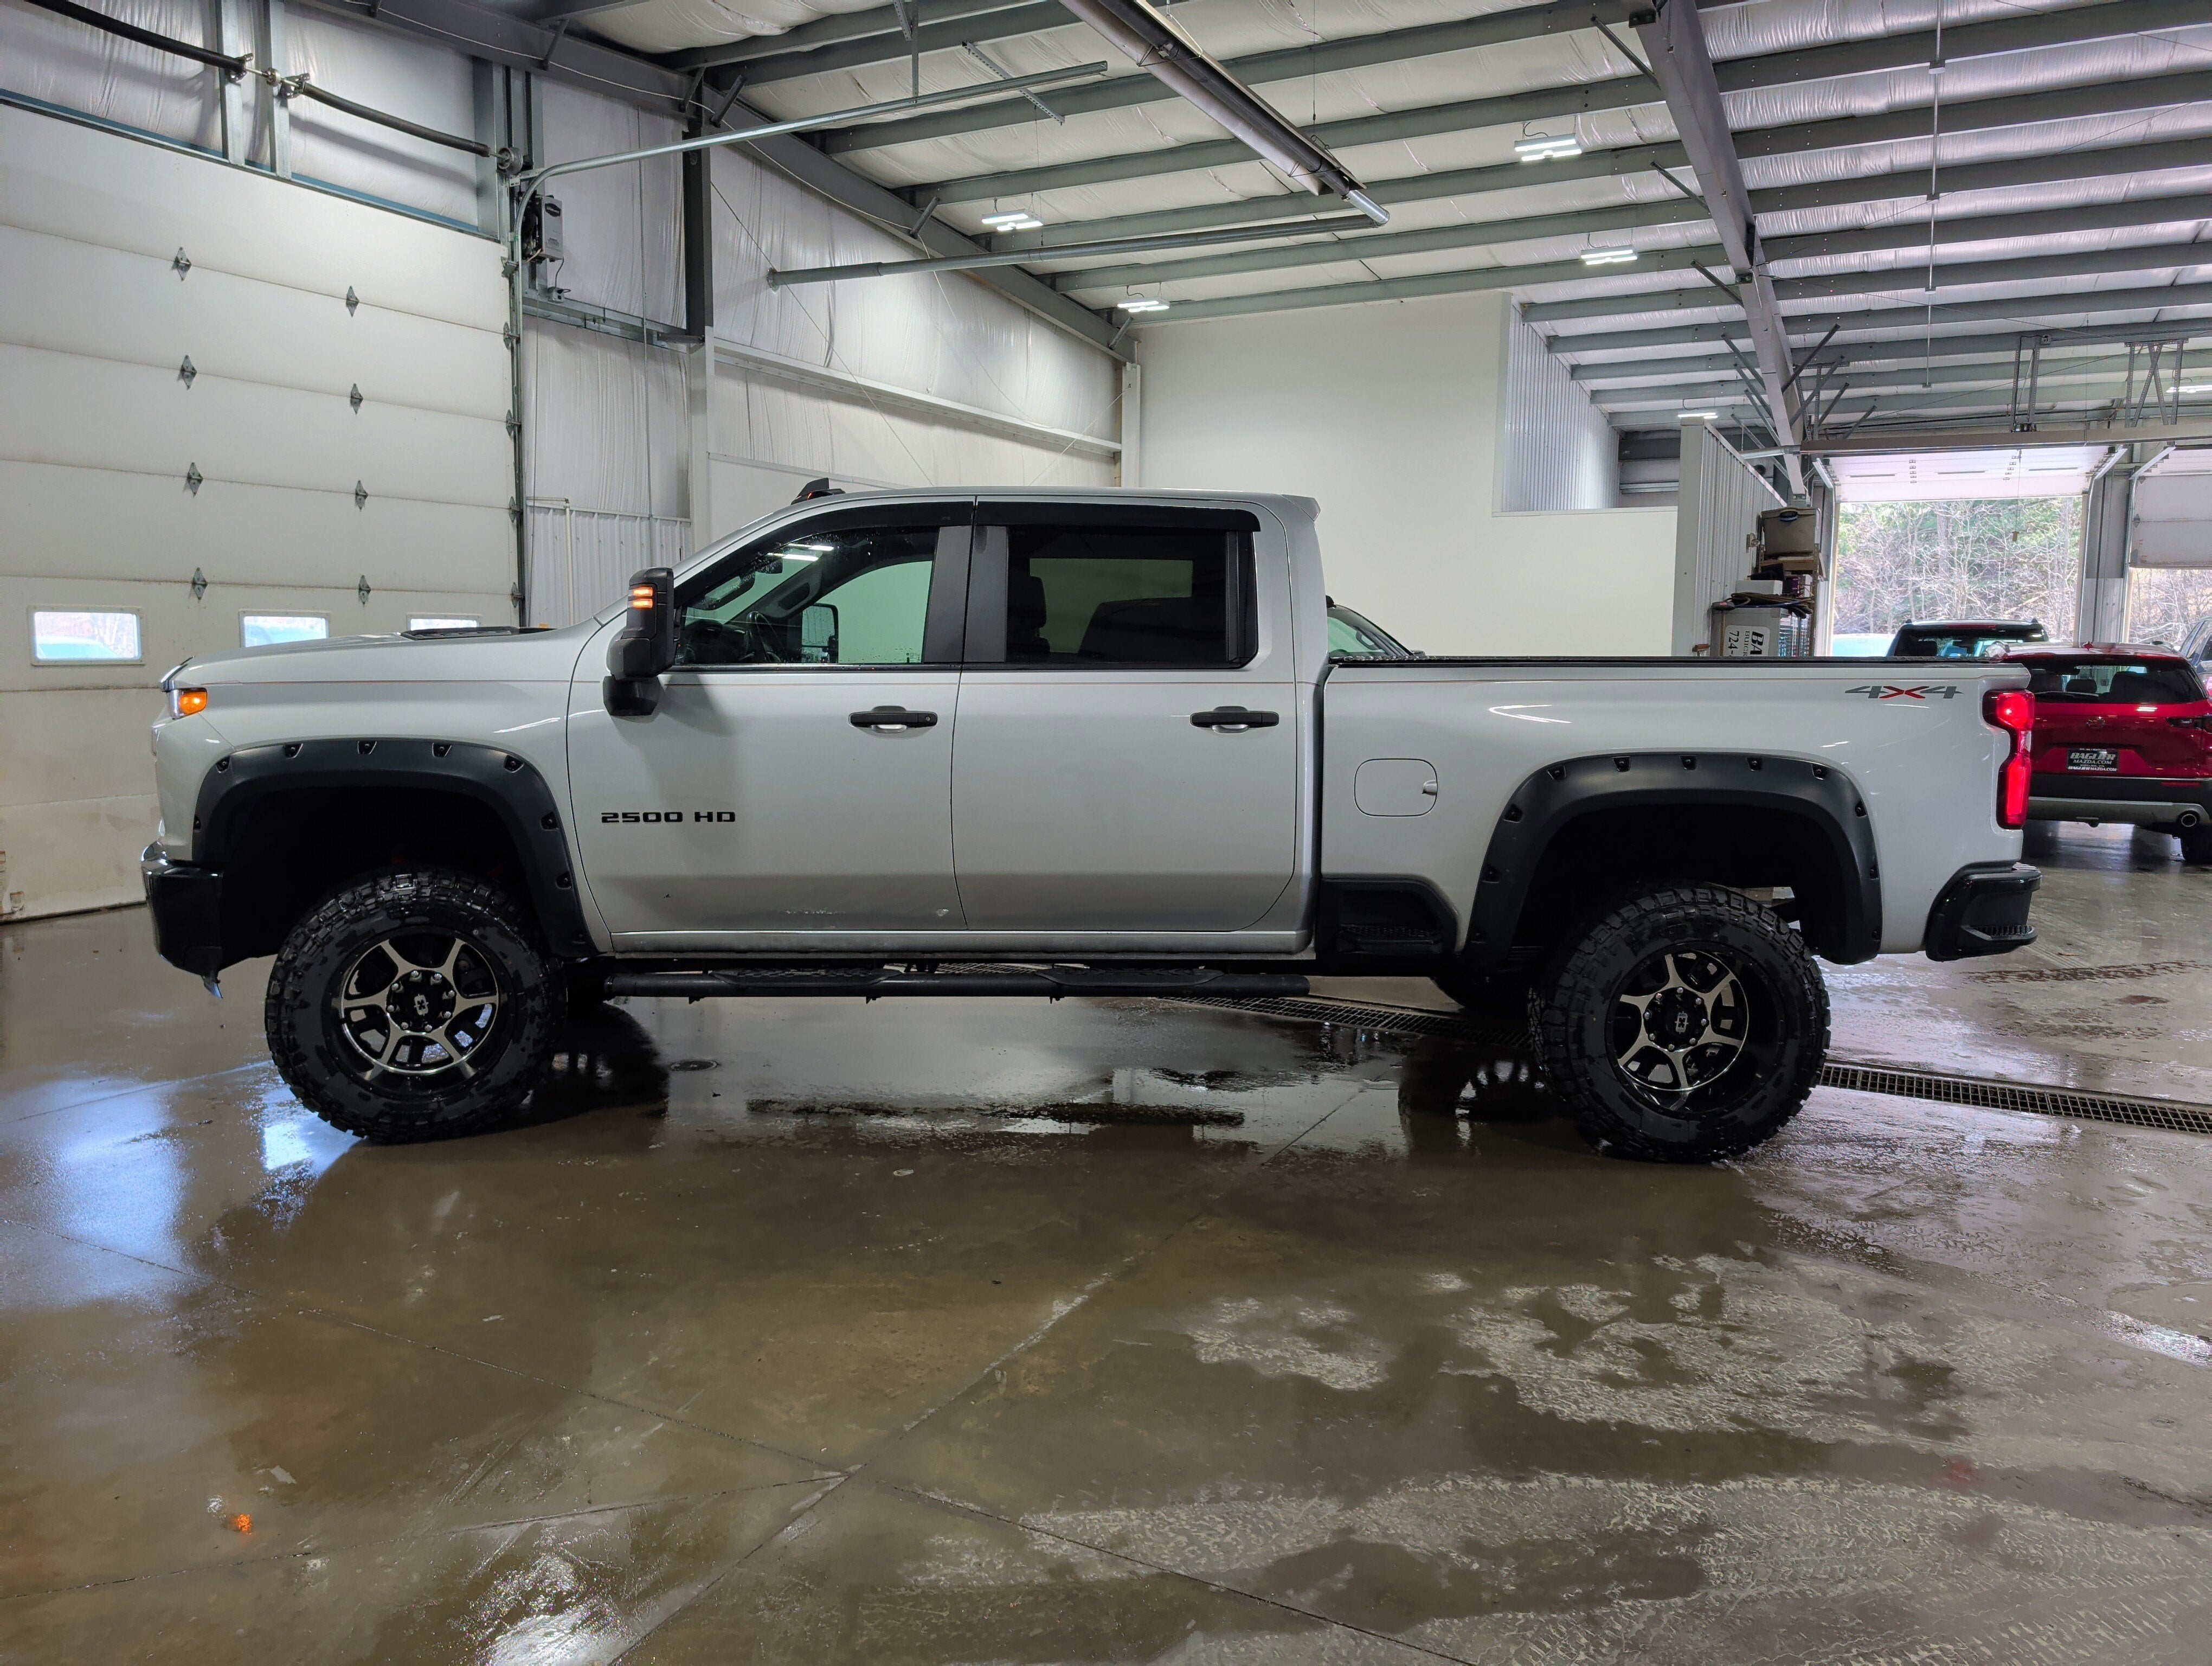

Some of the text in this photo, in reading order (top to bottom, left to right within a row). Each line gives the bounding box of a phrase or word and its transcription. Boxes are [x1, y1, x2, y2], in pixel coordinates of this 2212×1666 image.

[1728, 631, 1740, 656] 724-
[1845, 686, 1964, 699] 4X4
[601, 812, 736, 823] 2500 HD
